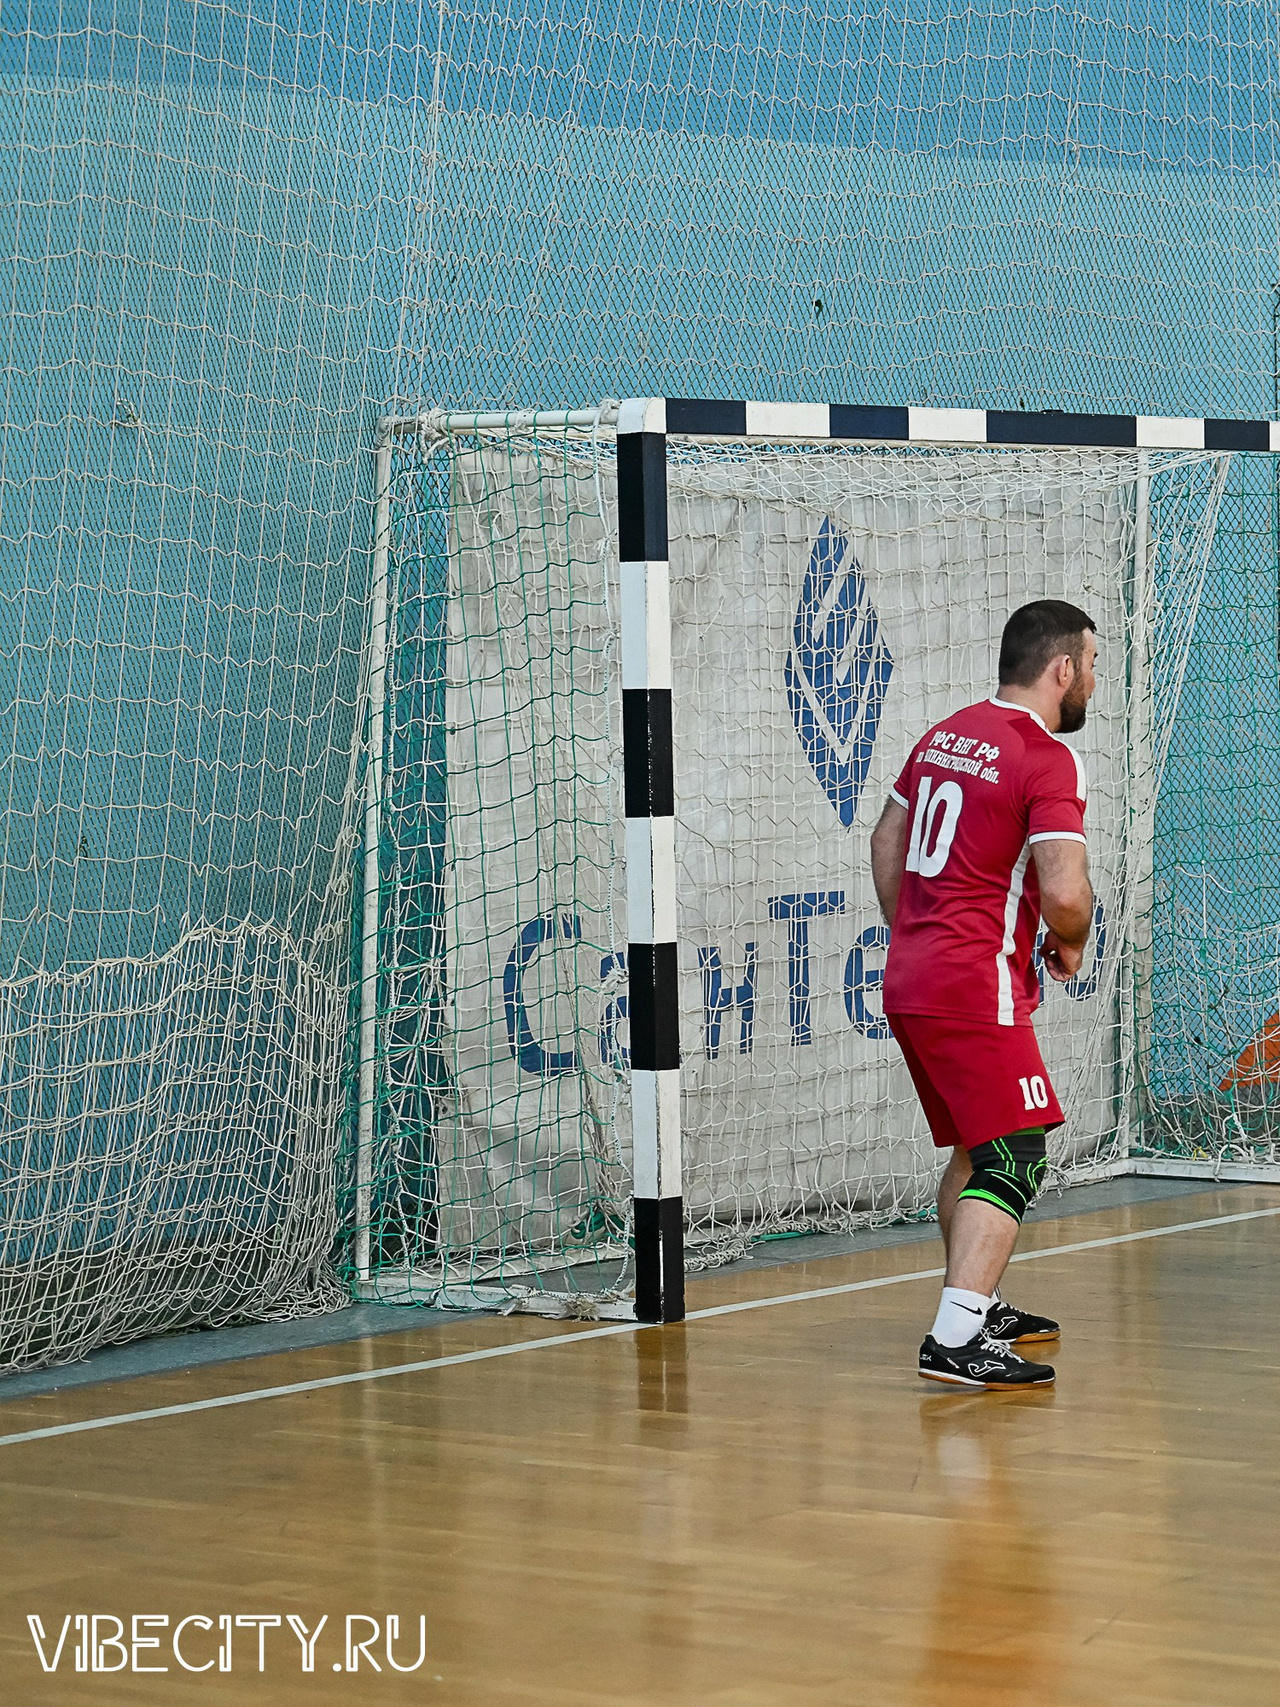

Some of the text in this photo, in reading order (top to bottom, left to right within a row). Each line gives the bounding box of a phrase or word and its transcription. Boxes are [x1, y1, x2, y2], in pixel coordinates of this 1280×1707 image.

[951, 736, 979, 755] ВНГ
[973, 742, 1000, 762] РФ
[980, 767, 1000, 785] обл.
[906, 776, 964, 878] 10
[1018, 1075, 1049, 1111] 10
